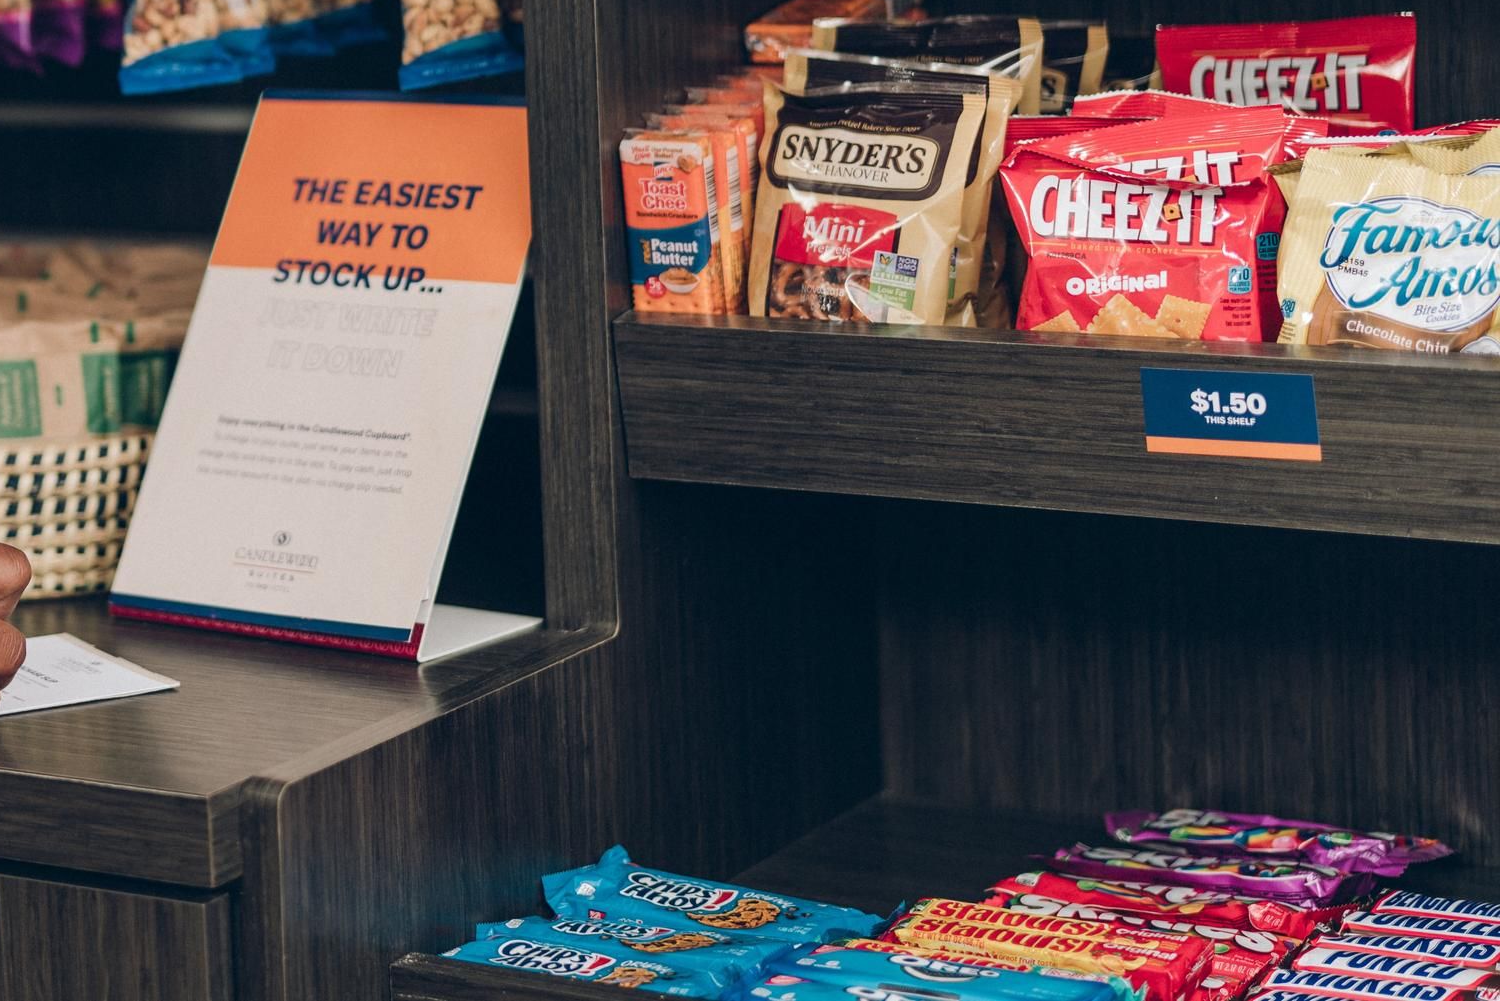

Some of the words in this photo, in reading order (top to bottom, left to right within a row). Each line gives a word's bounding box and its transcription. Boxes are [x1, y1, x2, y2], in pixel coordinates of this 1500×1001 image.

[782, 133, 927, 176] SNYDER'S
[639, 179, 686, 197] Toast
[824, 166, 889, 184] HANOVER
[294, 178, 348, 204] THE
[354, 180, 484, 211] EASIEST
[642, 195, 687, 210] Chee
[316, 220, 384, 248] WAY
[391, 224, 430, 250] TO
[802, 215, 866, 244] Mini
[1259, 234, 1278, 248] 210
[1320, 203, 1500, 269] Famous
[651, 238, 699, 253] Peanut
[652, 251, 694, 267] Butter
[273, 258, 376, 290] STOCK
[383, 265, 444, 294] UP...
[1348, 255, 1500, 309] Amos
[258, 297, 333, 330] JUST
[338, 302, 439, 338] WRITE
[1413, 304, 1439, 316] Bite
[1440, 301, 1462, 313] Size
[1425, 313, 1461, 324] Cookies
[1346, 319, 1413, 348] Chocolate
[266, 340, 297, 370] IT
[300, 342, 403, 379] DOWN
[1190, 387, 1267, 416] $1.50
[1204, 415, 1226, 425] THIS
[1227, 417, 1257, 427] SHELF
[621, 884, 738, 912] Ahoy!
[629, 872, 716, 900] Chips
[499, 939, 593, 963] Chips
[1018, 956, 1037, 967] fruit
[490, 953, 616, 976] Ahoy!
[888, 954, 1001, 979] OREO
